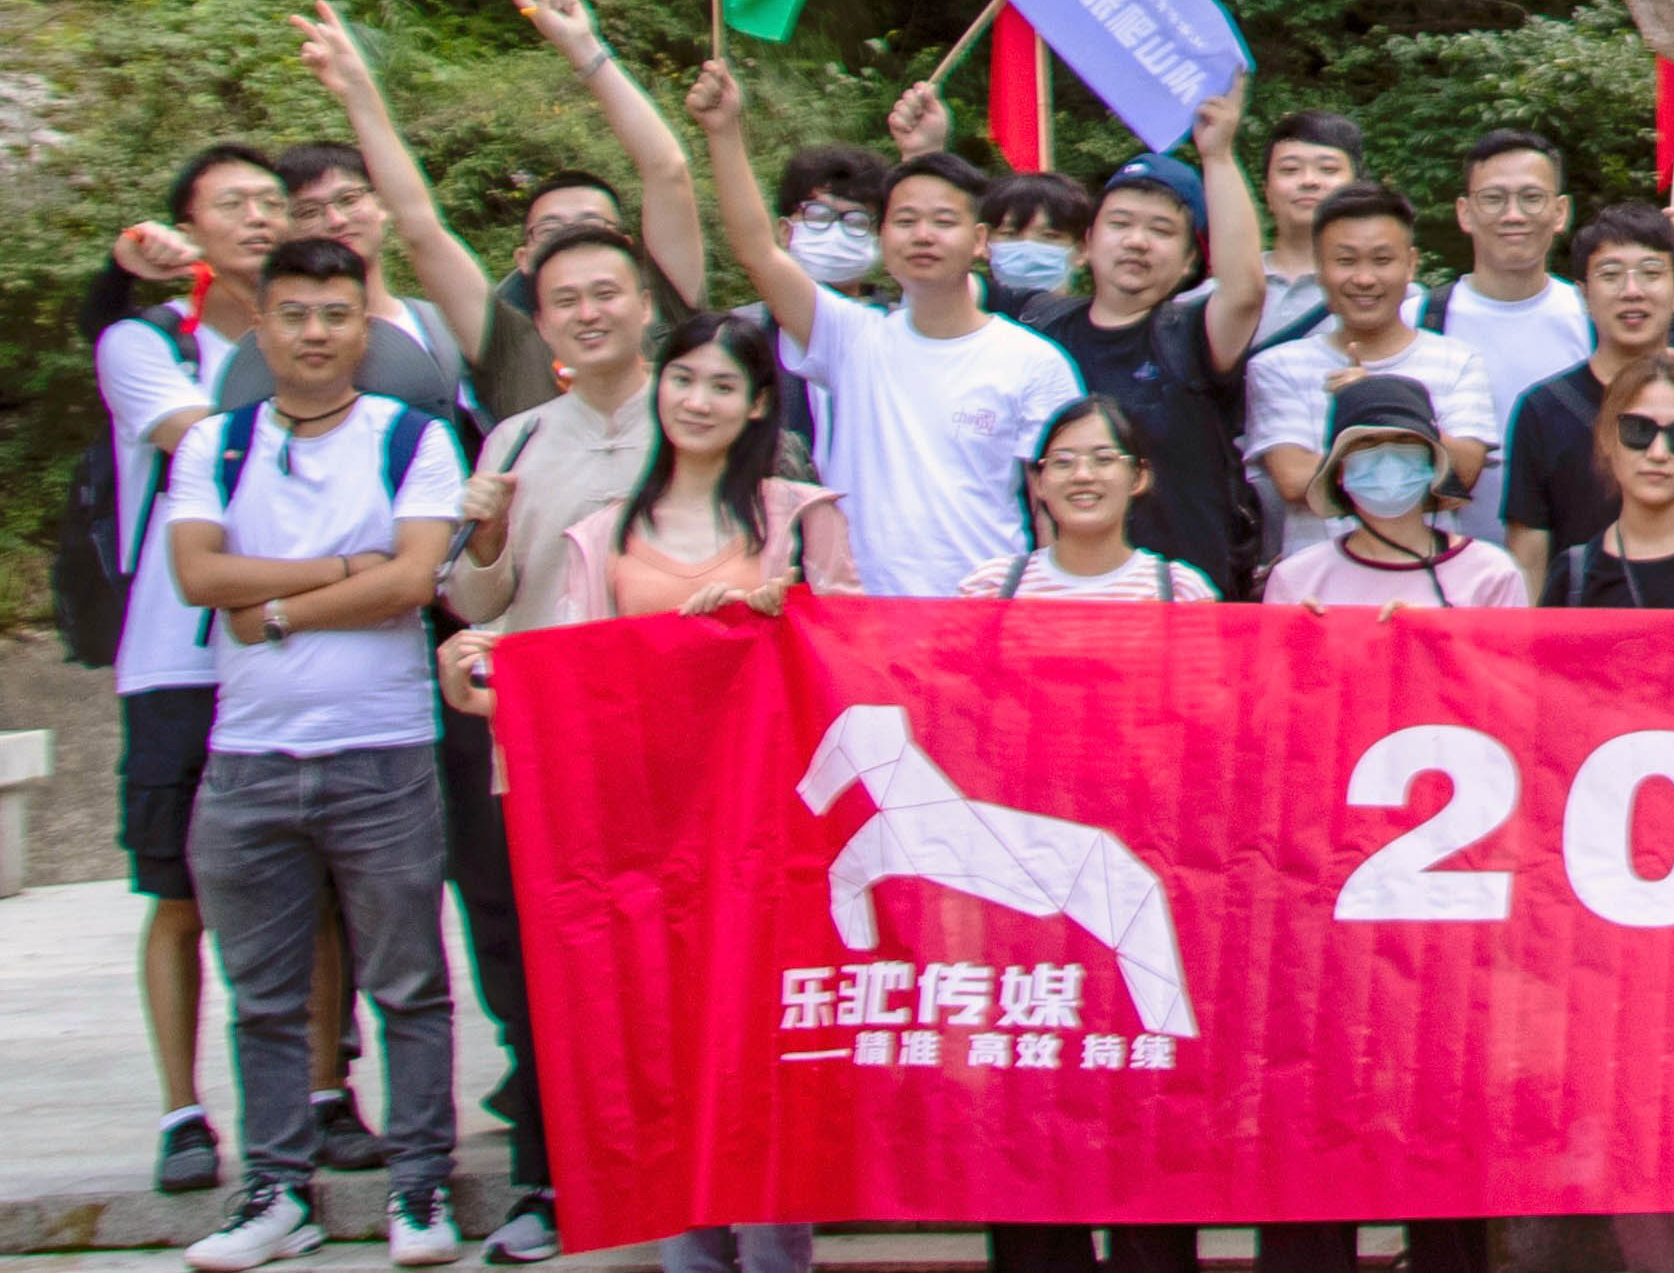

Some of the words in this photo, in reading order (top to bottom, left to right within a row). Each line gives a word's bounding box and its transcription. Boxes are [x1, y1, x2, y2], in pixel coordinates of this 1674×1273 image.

[781, 960, 1084, 1030] 乐驰传媒
[854, 1031, 941, 1066] 精准
[968, 1032, 1062, 1068] 高效
[1080, 1034, 1177, 1069] 持续
